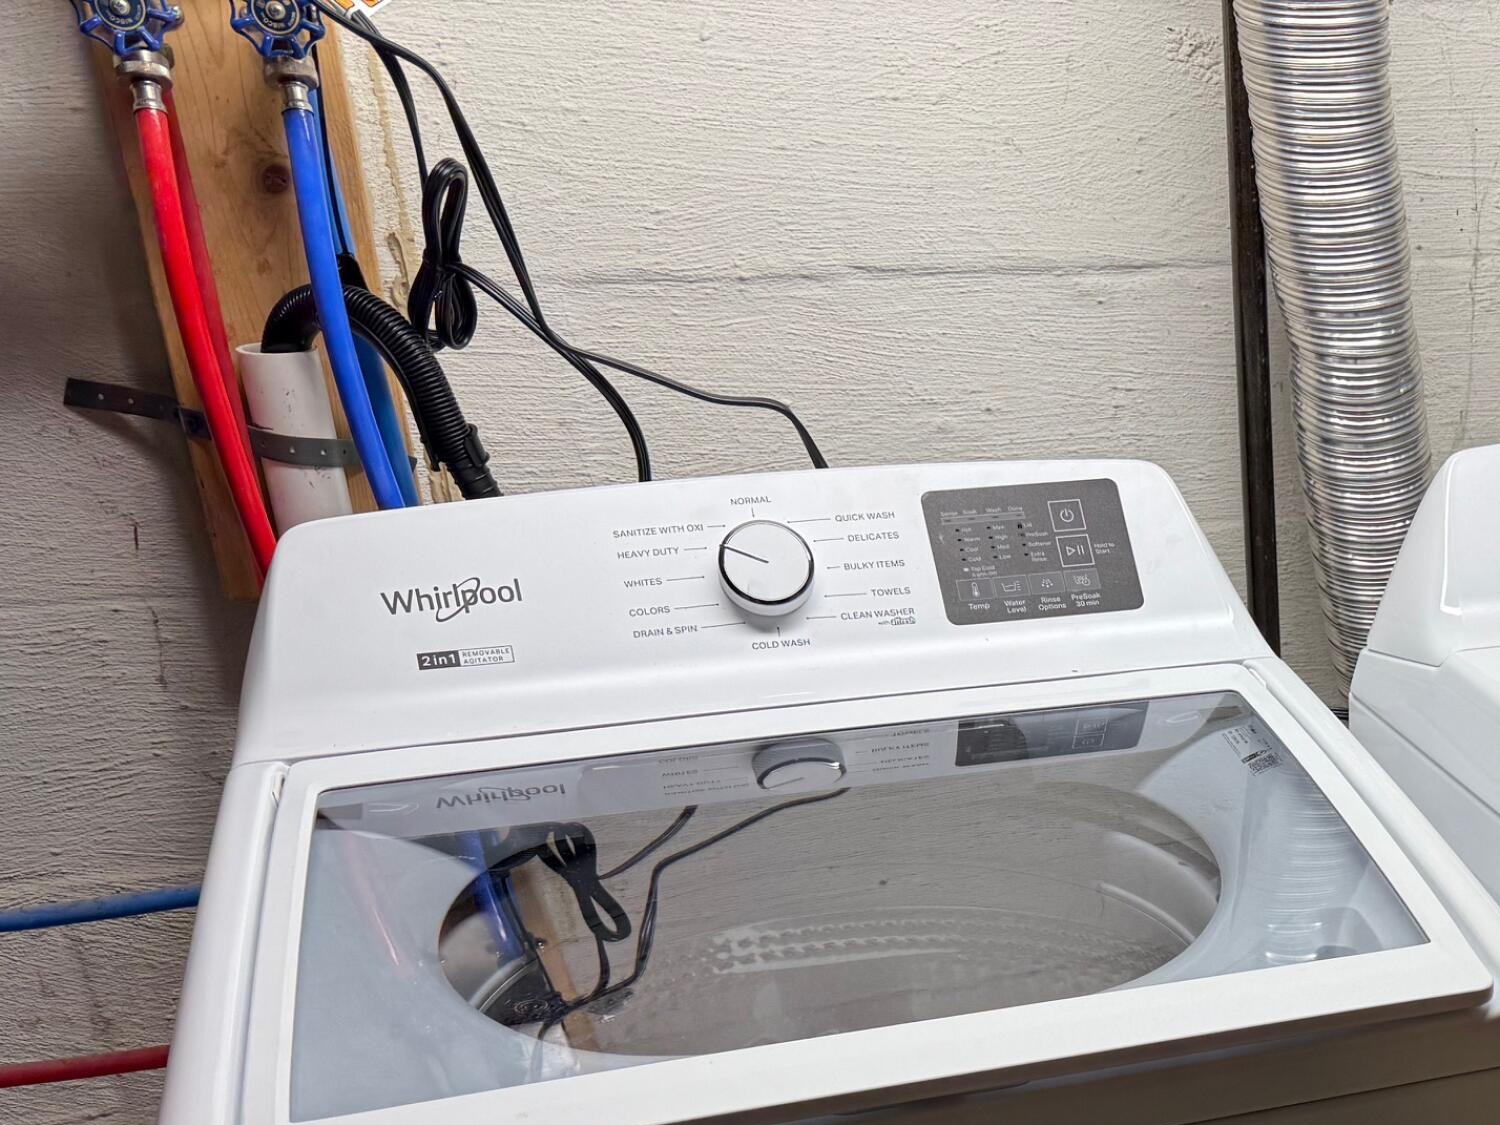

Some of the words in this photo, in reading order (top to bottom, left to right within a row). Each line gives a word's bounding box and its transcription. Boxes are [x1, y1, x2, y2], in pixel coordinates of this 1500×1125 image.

[729, 495, 772, 506] NORMAL
[835, 512, 865, 523] QUICK
[866, 511, 895, 521] WASH
[612, 527, 656, 539] SANITIZE
[657, 525, 685, 536] WITH
[686, 523, 704, 534] OXI
[847, 531, 900, 542] DELICATES
[616, 548, 651, 560] HEAVY
[653, 546, 680, 557] DUTY
[843, 561, 875, 571] BULKY
[876, 559, 905, 569] ITEMS
[623, 576, 663, 589] WHITES
[870, 586, 911, 597] TOWELS
[1071, 592, 1101, 601] PreSoak
[380, 577, 523, 623] Whirlpool
[1003, 599, 1026, 607] Water
[628, 604, 671, 617] COLORS
[968, 602, 990, 611] Temp
[1007, 606, 1027, 614] Level
[1038, 603, 1067, 611] Options
[840, 610, 872, 621] CLEAN
[873, 607, 915, 618] WASHER
[632, 627, 664, 639] DRAIN
[665, 626, 674, 636] &
[674, 624, 698, 635] SPIN
[751, 639, 780, 651] COLD
[780, 637, 811, 649] WASH
[462, 647, 510, 658] REMOVABLE
[463, 655, 504, 665] AGITATOR
